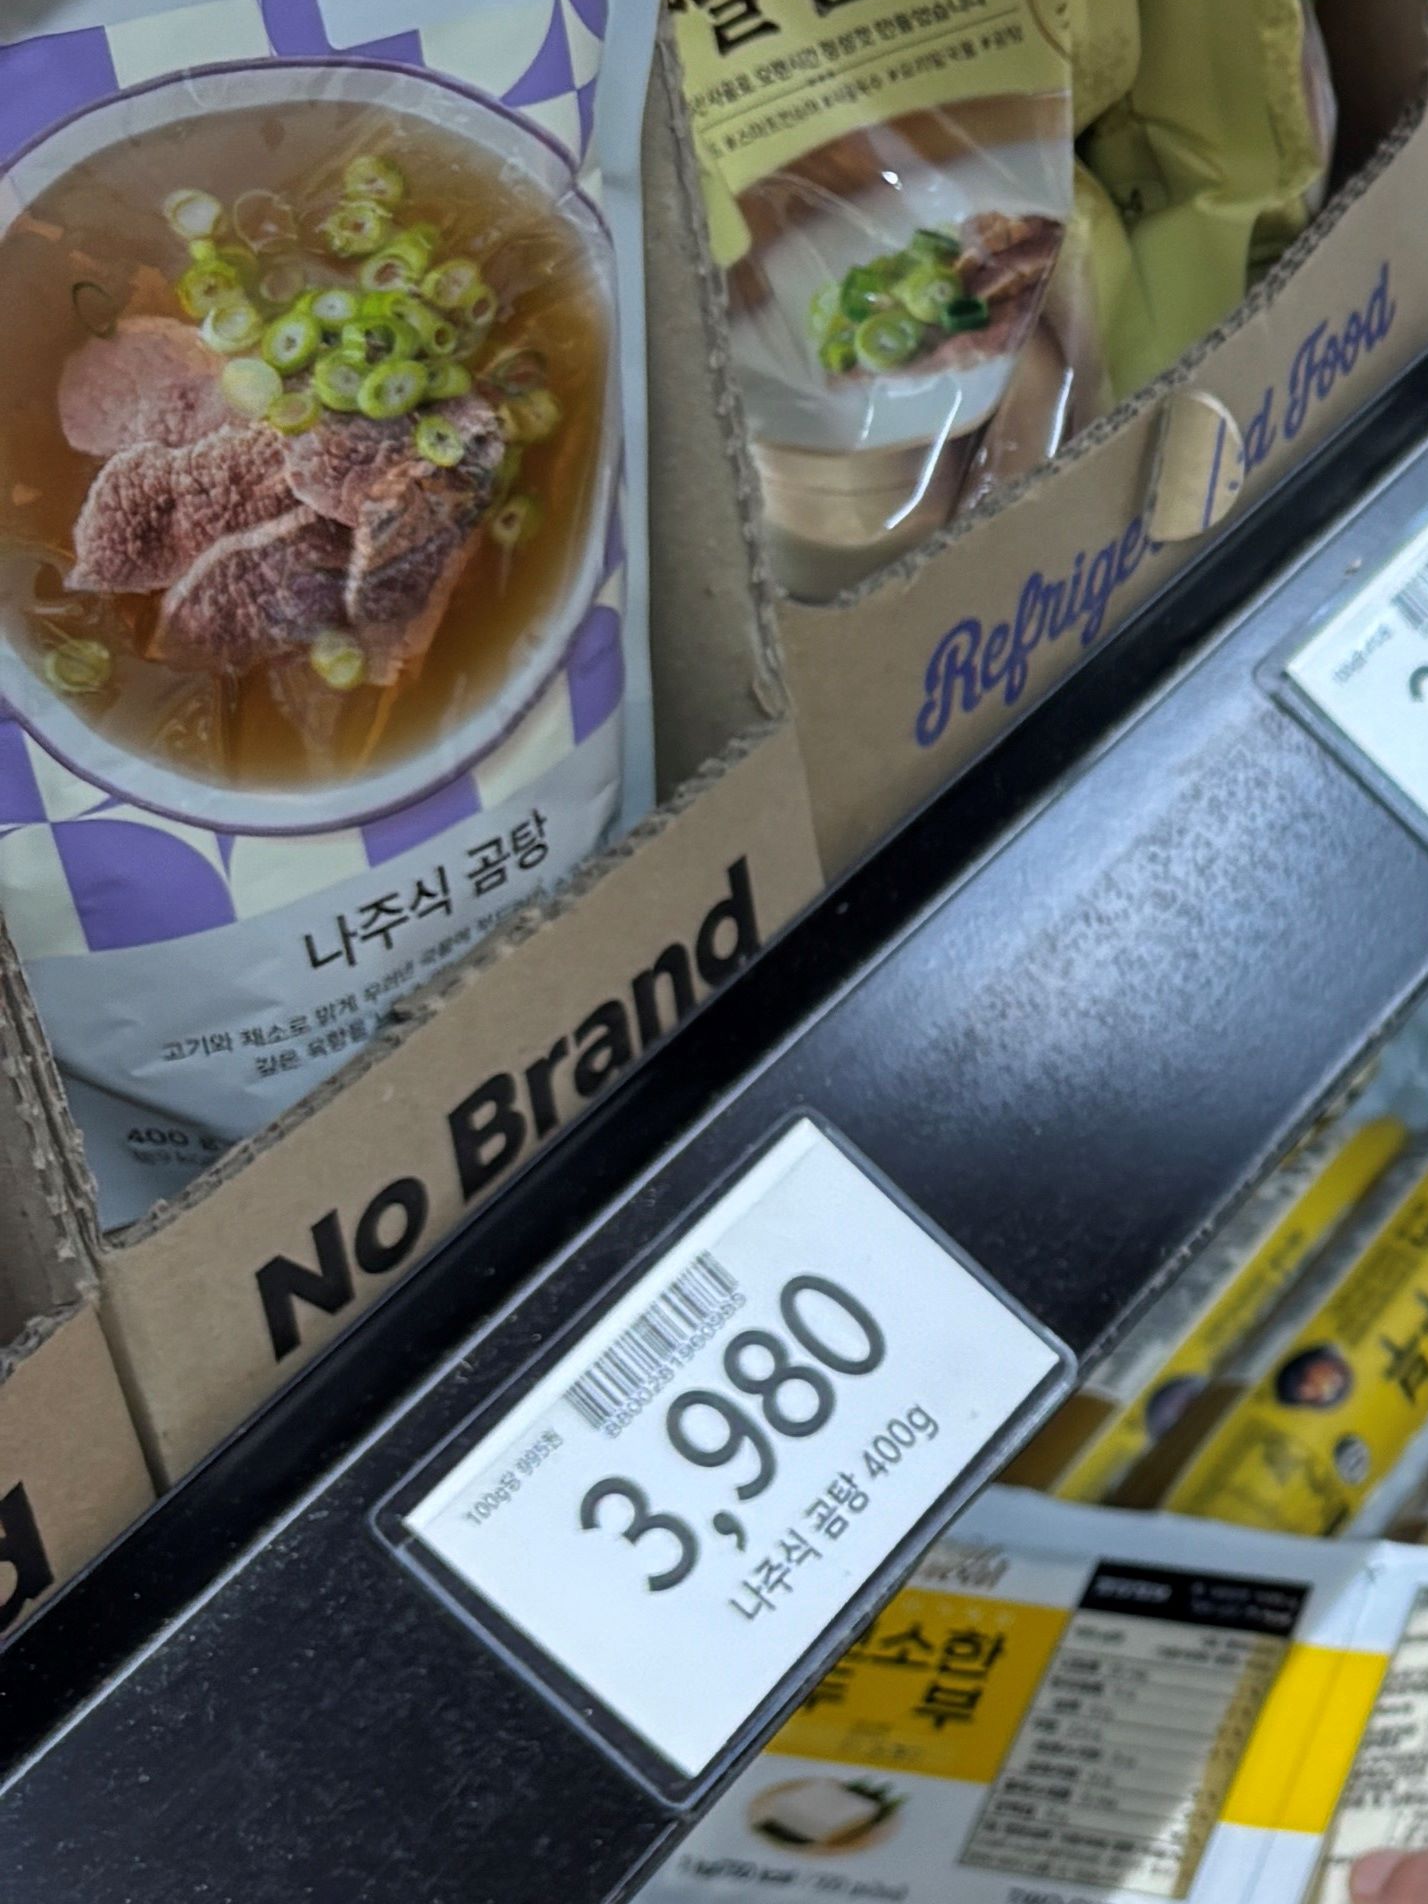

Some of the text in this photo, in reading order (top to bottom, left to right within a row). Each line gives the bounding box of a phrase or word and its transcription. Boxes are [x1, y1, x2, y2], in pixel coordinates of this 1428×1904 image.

[1284, 261, 1396, 443] Food
[304, 808, 550, 969] 나주식 곰탕
[127, 1126, 190, 1147] 400
[161, 1031, 233, 1062] 고기와
[254, 853, 764, 1365] No Brand
[579, 1270, 887, 1593] 3,980
[728, 1402, 941, 1623] 나주식 곰탕 400g
